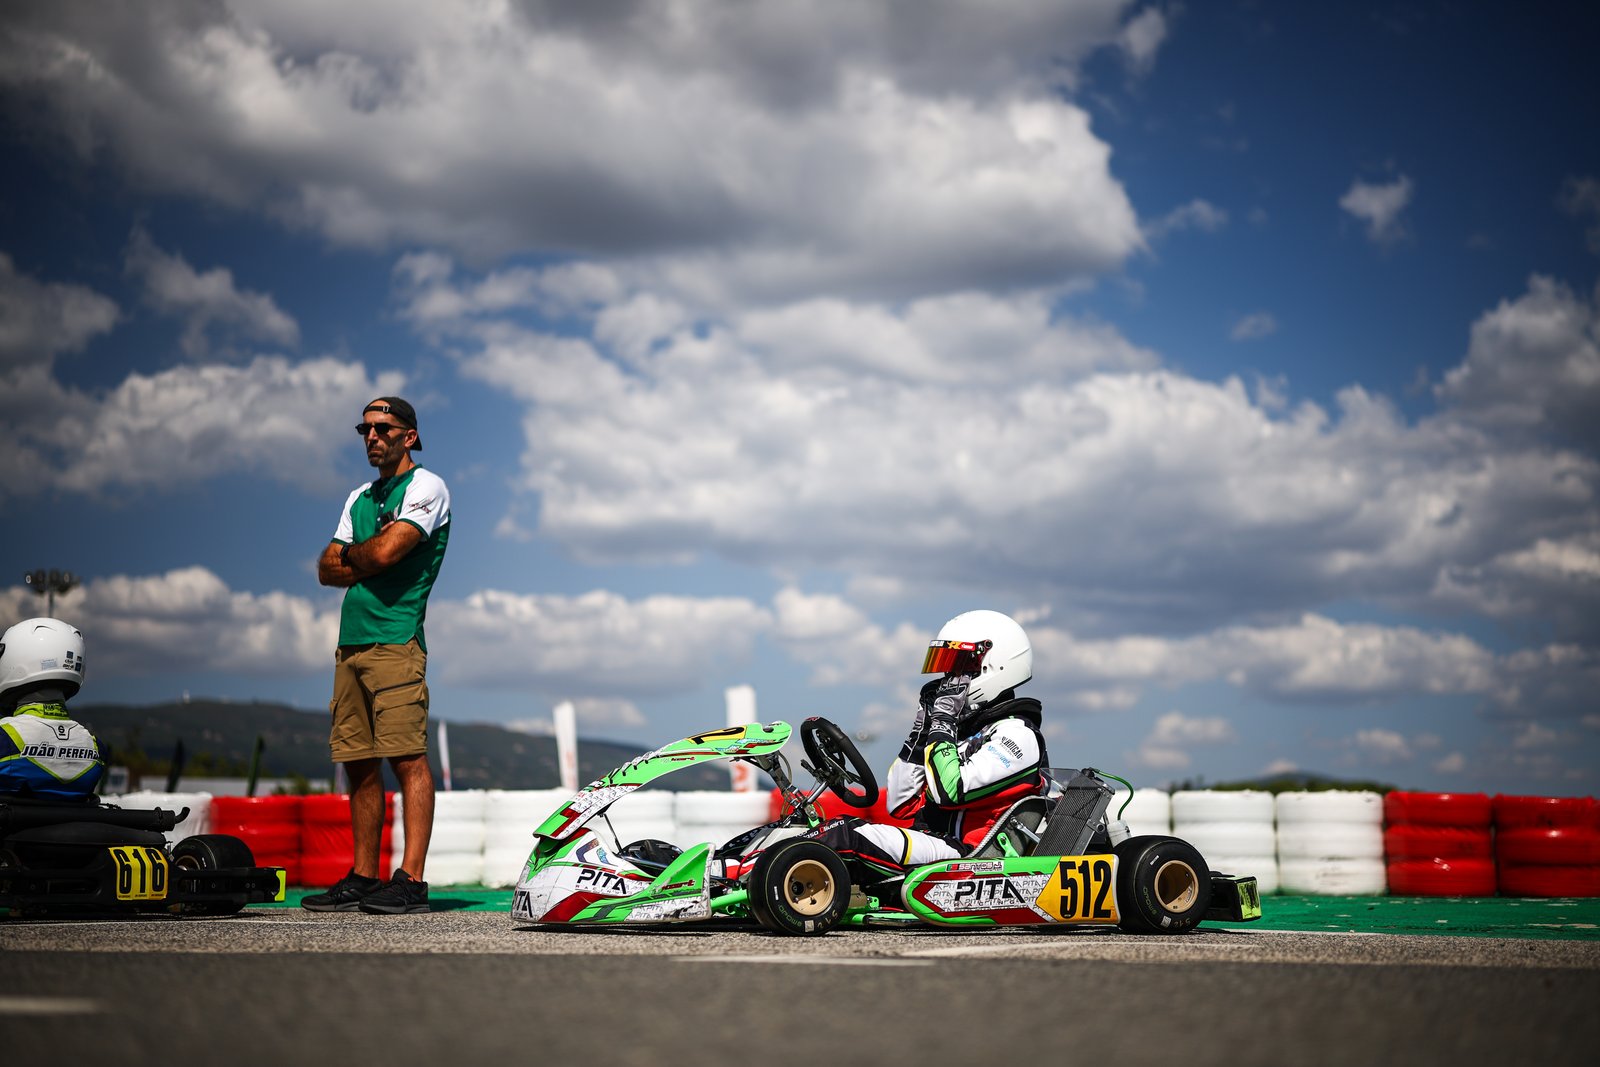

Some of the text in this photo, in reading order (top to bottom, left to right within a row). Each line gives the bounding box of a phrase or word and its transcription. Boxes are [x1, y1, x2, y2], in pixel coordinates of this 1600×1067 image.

[22, 743, 56, 757] JOÃO
[112, 849, 165, 894] 616
[576, 868, 627, 895] PITA
[955, 879, 1026, 903] PITA
[1060, 860, 1112, 919] 512
